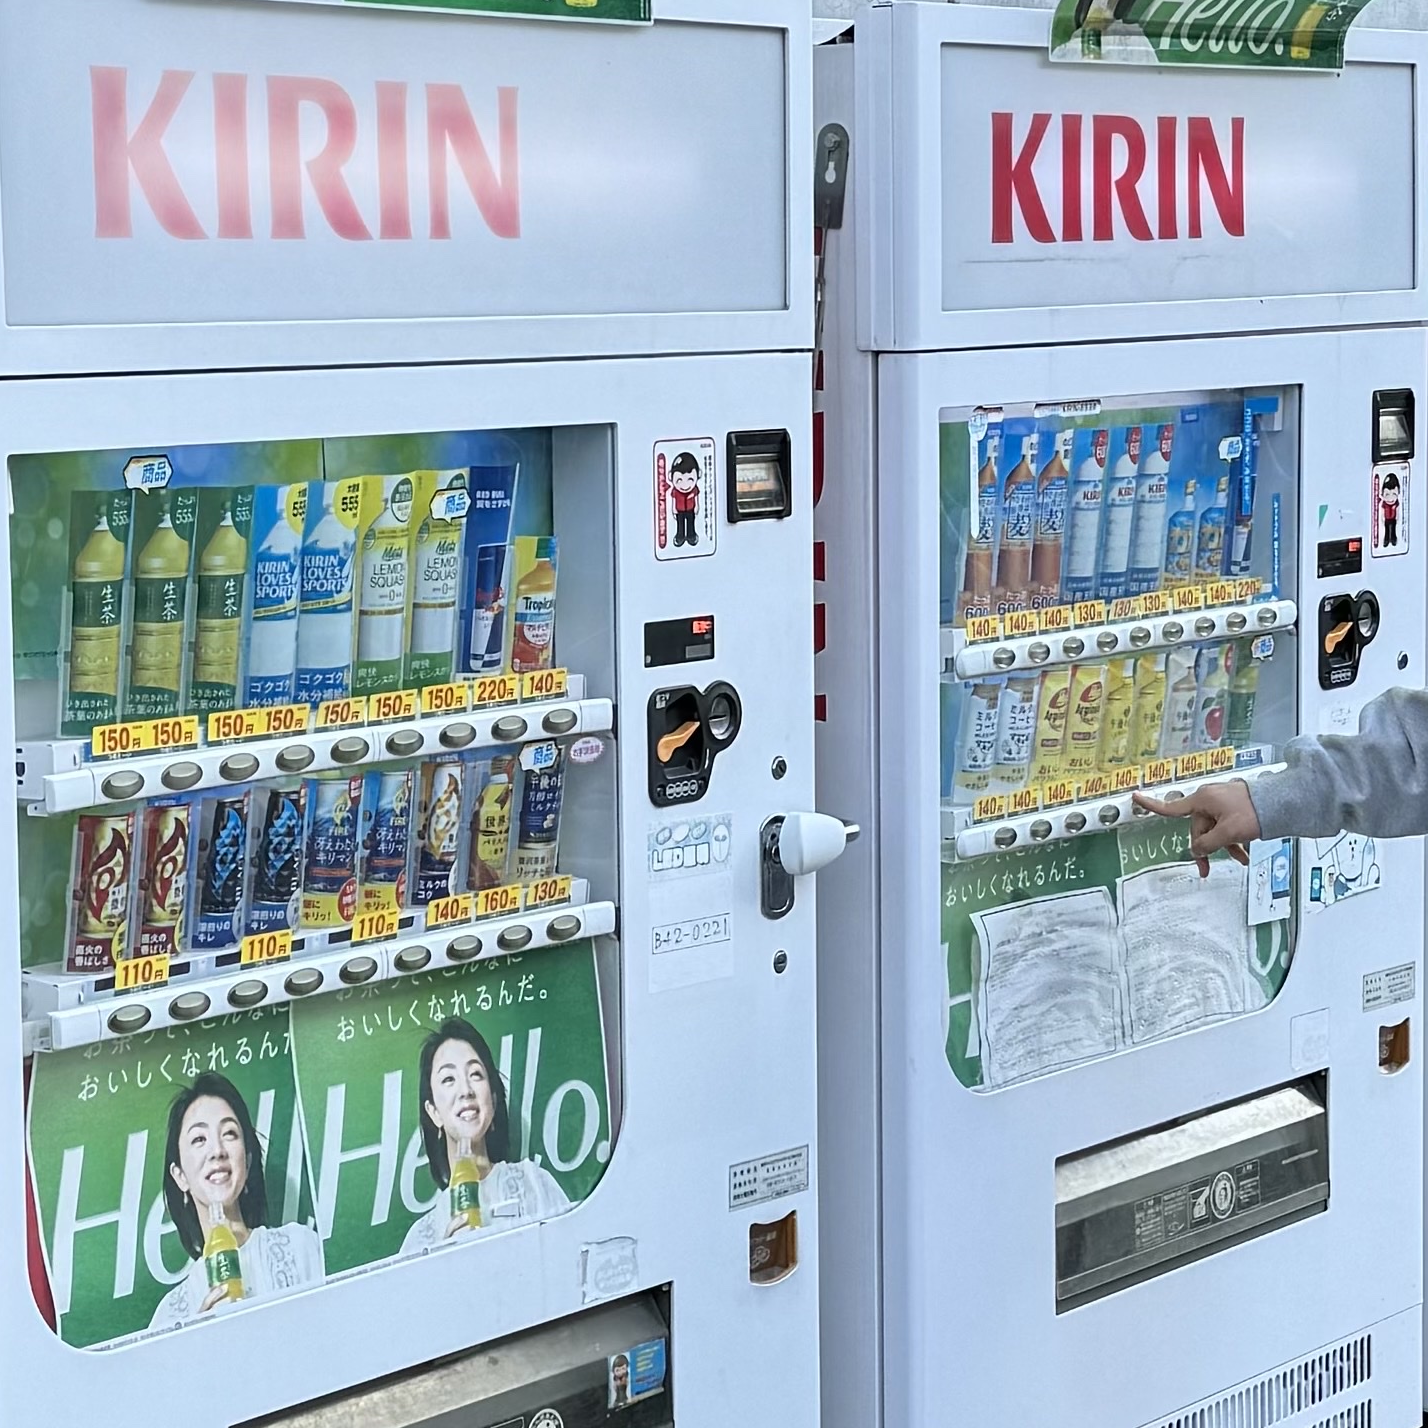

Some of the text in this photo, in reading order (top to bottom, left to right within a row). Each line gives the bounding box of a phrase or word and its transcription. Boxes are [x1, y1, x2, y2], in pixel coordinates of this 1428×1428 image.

[89, 64, 522, 241] KIRIN
[991, 111, 1245, 244] KIRIN
[141, 461, 169, 484] 商品
[444, 493, 467, 515] 商品
[257, 560, 291, 574] KIRIN
[303, 555, 339, 568] KIRIN
[256, 572, 293, 586] LOVES
[302, 566, 341, 581] LOVES
[99, 584, 116, 626] 生茶
[161, 580, 178, 622] 生茶
[223, 578, 239, 619] 生茶
[1176, 590, 1200, 606] 140円
[1009, 614, 1034, 631] 140円
[1044, 609, 1069, 626] 140円
[1078, 604, 1103, 622] 130円
[971, 620, 997, 637] 140円
[298, 669, 344, 686] ゴクゴク
[529, 672, 563, 695] 140円
[427, 687, 463, 710] 150円
[477, 678, 515, 702] 220円
[323, 701, 360, 725] 150円
[375, 694, 412, 718] 150円
[215, 712, 254, 738] 150円
[265, 708, 303, 732] 150円
[99, 727, 142, 754] 150円
[151, 720, 193, 745] 150円
[1181, 755, 1203, 773] 140円
[1210, 748, 1232, 766] 140円
[1115, 769, 1138, 788] 140円
[1148, 763, 1171, 781] 140円
[1048, 783, 1072, 802] 140円
[1083, 775, 1108, 794] 140円
[978, 799, 1003, 817] 140円
[1013, 790, 1038, 809] 140円
[533, 879, 566, 902] 130円
[944, 856, 1087, 908] おいしくなれるんだ。
[417, 890, 433, 900] コク
[483, 889, 517, 912] 160円
[434, 898, 469, 922] 140円
[250, 921, 268, 931] キレ
[358, 914, 394, 938] 110円
[654, 916, 729, 951] B42-0221
[141, 933, 167, 944] 直火の
[197, 933, 215, 943] キレ
[248, 935, 287, 961] 110円
[74, 945, 103, 956] 直火の
[74, 955, 109, 967] 香ばしさ
[121, 960, 164, 988] 110円
[335, 972, 549, 1043] おいしくなれるんだ。
